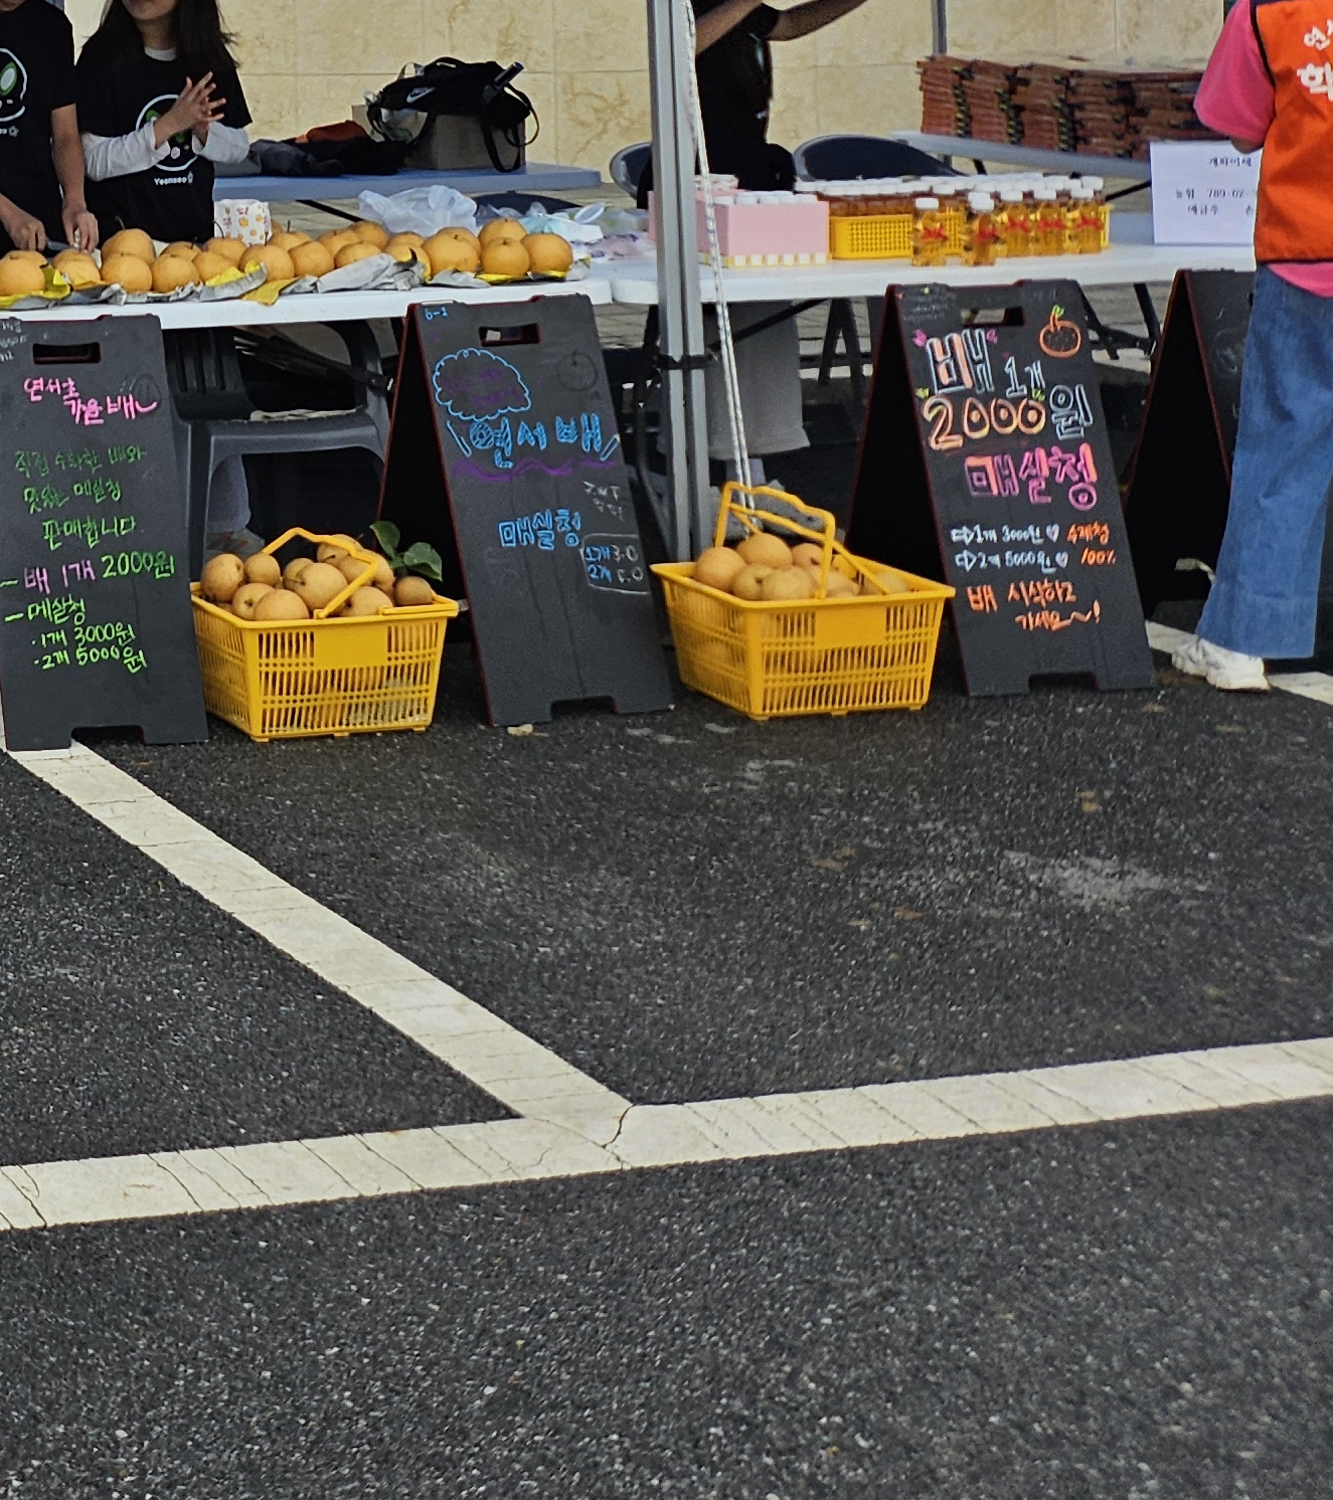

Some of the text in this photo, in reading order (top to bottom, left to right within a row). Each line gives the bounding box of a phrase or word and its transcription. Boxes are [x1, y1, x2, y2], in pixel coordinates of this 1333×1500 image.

[925, 328, 1046, 399] 배 1개
[23, 376, 80, 403] 연서초
[62, 393, 137, 426] 가을 배
[922, 383, 1094, 451] 2000원
[468, 415, 548, 469] 연서
[964, 441, 1098, 512] 매실청
[42, 514, 138, 551] 판매합니다
[497, 508, 582, 551] 매실청
[23, 567, 52, 595] 배
[61, 559, 96, 588] 1개
[100, 550, 175, 579] 2000원
[966, 583, 998, 614] 배
[74, 621, 136, 647] 3000원
[75, 645, 148, 674] 5000원
